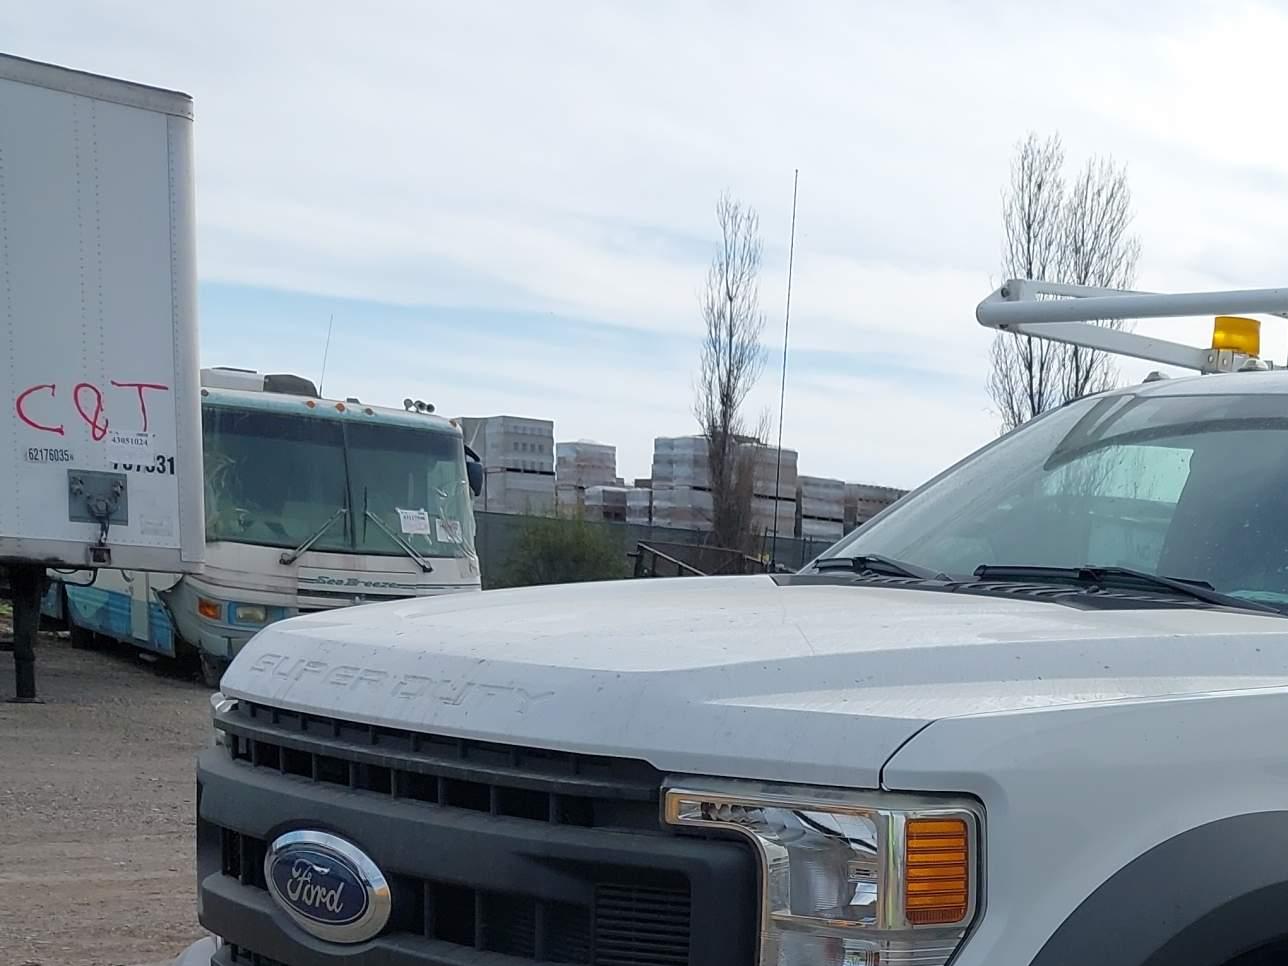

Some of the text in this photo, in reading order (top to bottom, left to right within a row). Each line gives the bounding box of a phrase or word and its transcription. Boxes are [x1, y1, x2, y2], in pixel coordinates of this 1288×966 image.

[250, 652, 557, 714] SUPER DUTY
[286, 858, 346, 913] Ford
